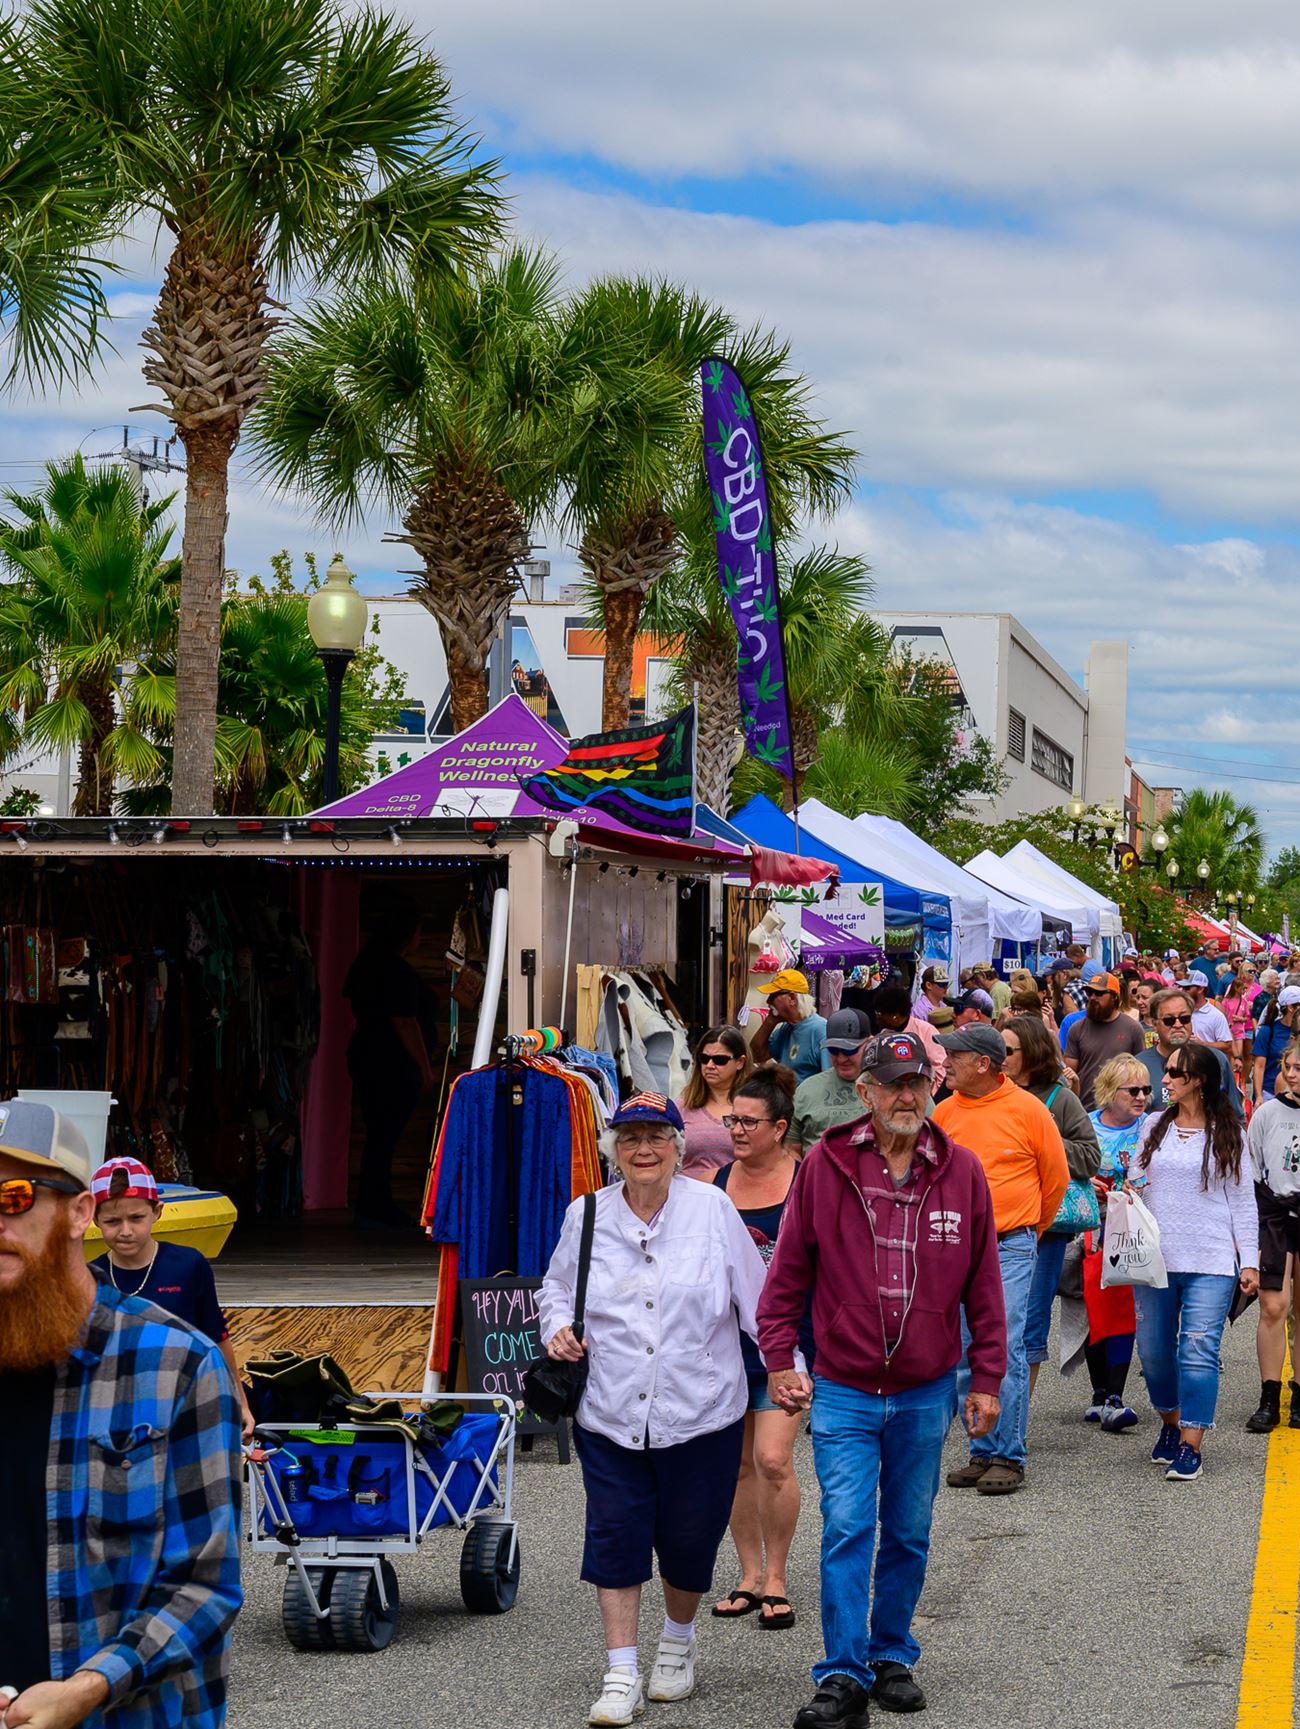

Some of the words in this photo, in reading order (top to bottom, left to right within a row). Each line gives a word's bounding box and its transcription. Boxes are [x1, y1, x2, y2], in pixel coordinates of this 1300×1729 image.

[723, 427, 763, 541] CBD
[461, 742, 537, 752] Natural
[441, 756, 544, 769] Dragonfly
[388, 794, 421, 803] CBD
[365, 804, 416, 814] Delta-8
[826, 913, 844, 921] Med
[846, 913, 866, 921] Card
[1004, 960, 1020, 970] $10
[471, 1290, 501, 1325] HEY
[484, 1330, 540, 1365] COME
[482, 1371, 513, 1394] on
